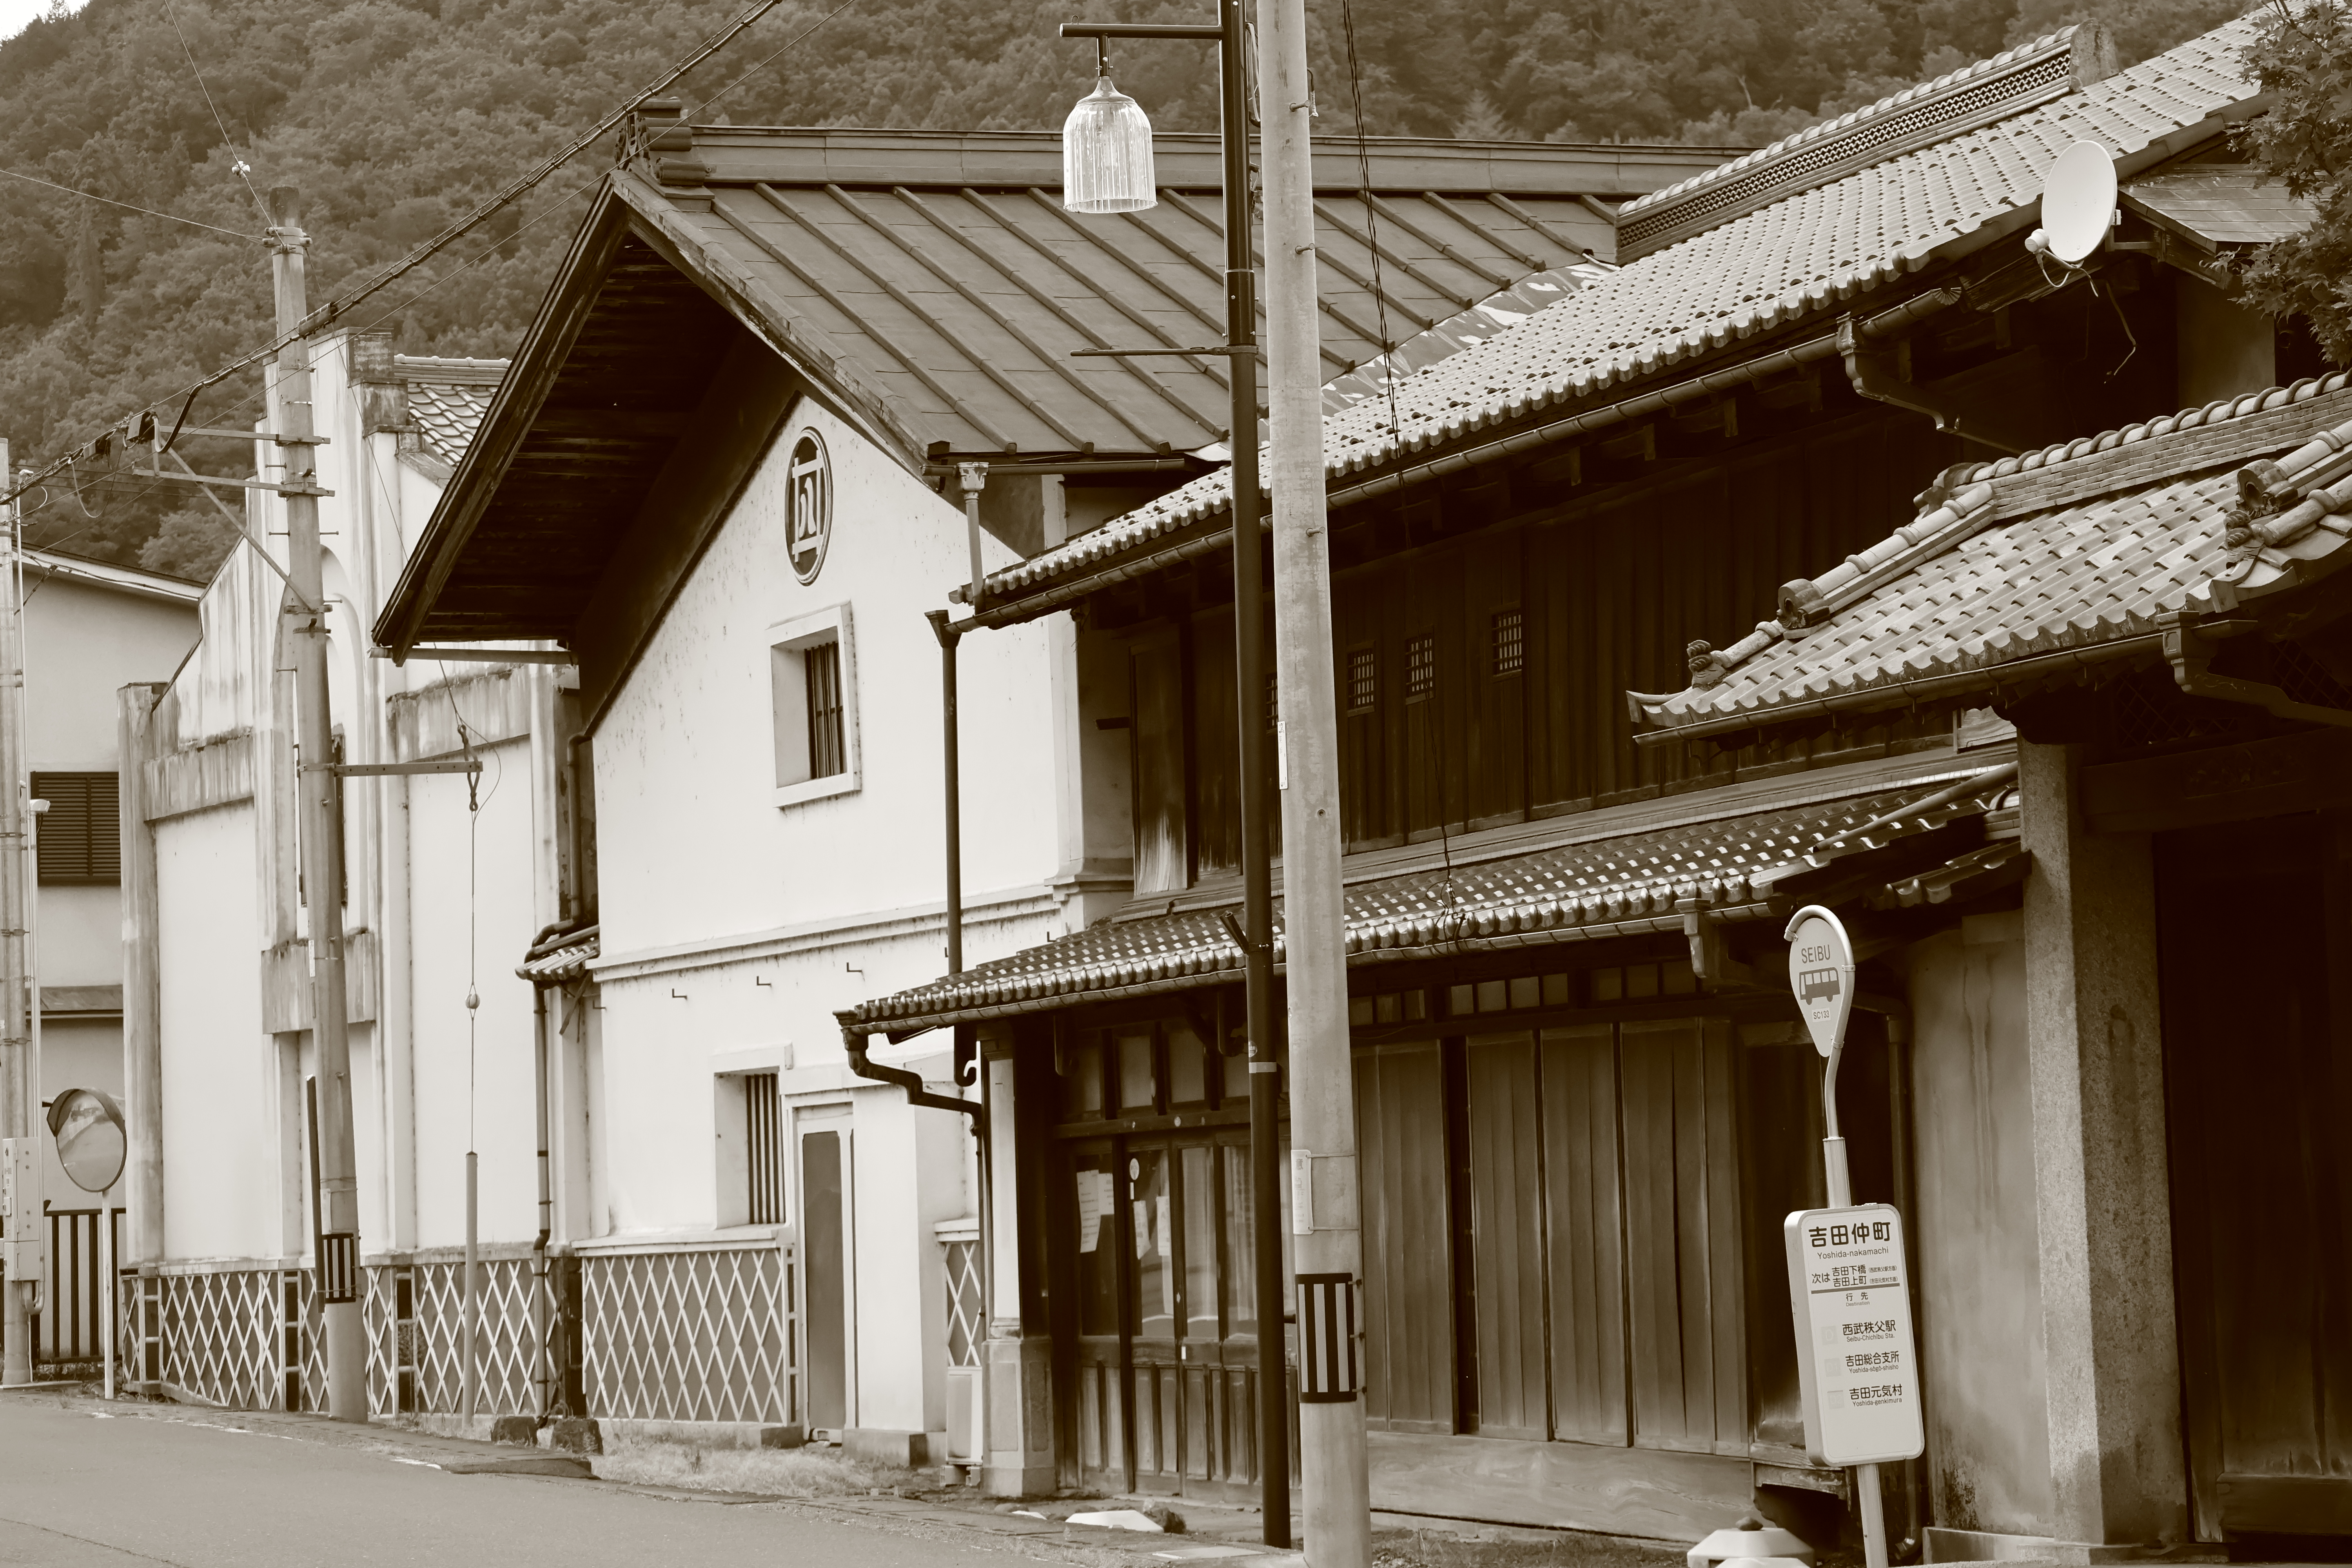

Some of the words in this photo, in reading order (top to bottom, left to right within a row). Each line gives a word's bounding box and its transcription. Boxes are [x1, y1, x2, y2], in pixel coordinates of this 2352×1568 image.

[1801, 944, 1830, 964] SEIBU
[1813, 1011, 1829, 1019] SC133
[1809, 1222, 1890, 1247] 吉田仲町
[1817, 1247, 1889, 1259] Yoshida-nakamachi
[1832, 1264, 1866, 1277] 吉田下橋
[1811, 1272, 1831, 1284] 次は
[1833, 1275, 1867, 1287] 吉田上町
[1842, 1319, 1896, 1336] 西武秩父駅
[1846, 1334, 1884, 1342] Seibu-Chichibu
[1846, 1351, 1900, 1367] 吉田総合支所
[1849, 1383, 1902, 1400] 吉田元気村
[1853, 1397, 1902, 1406] Yoshida-genkimura
